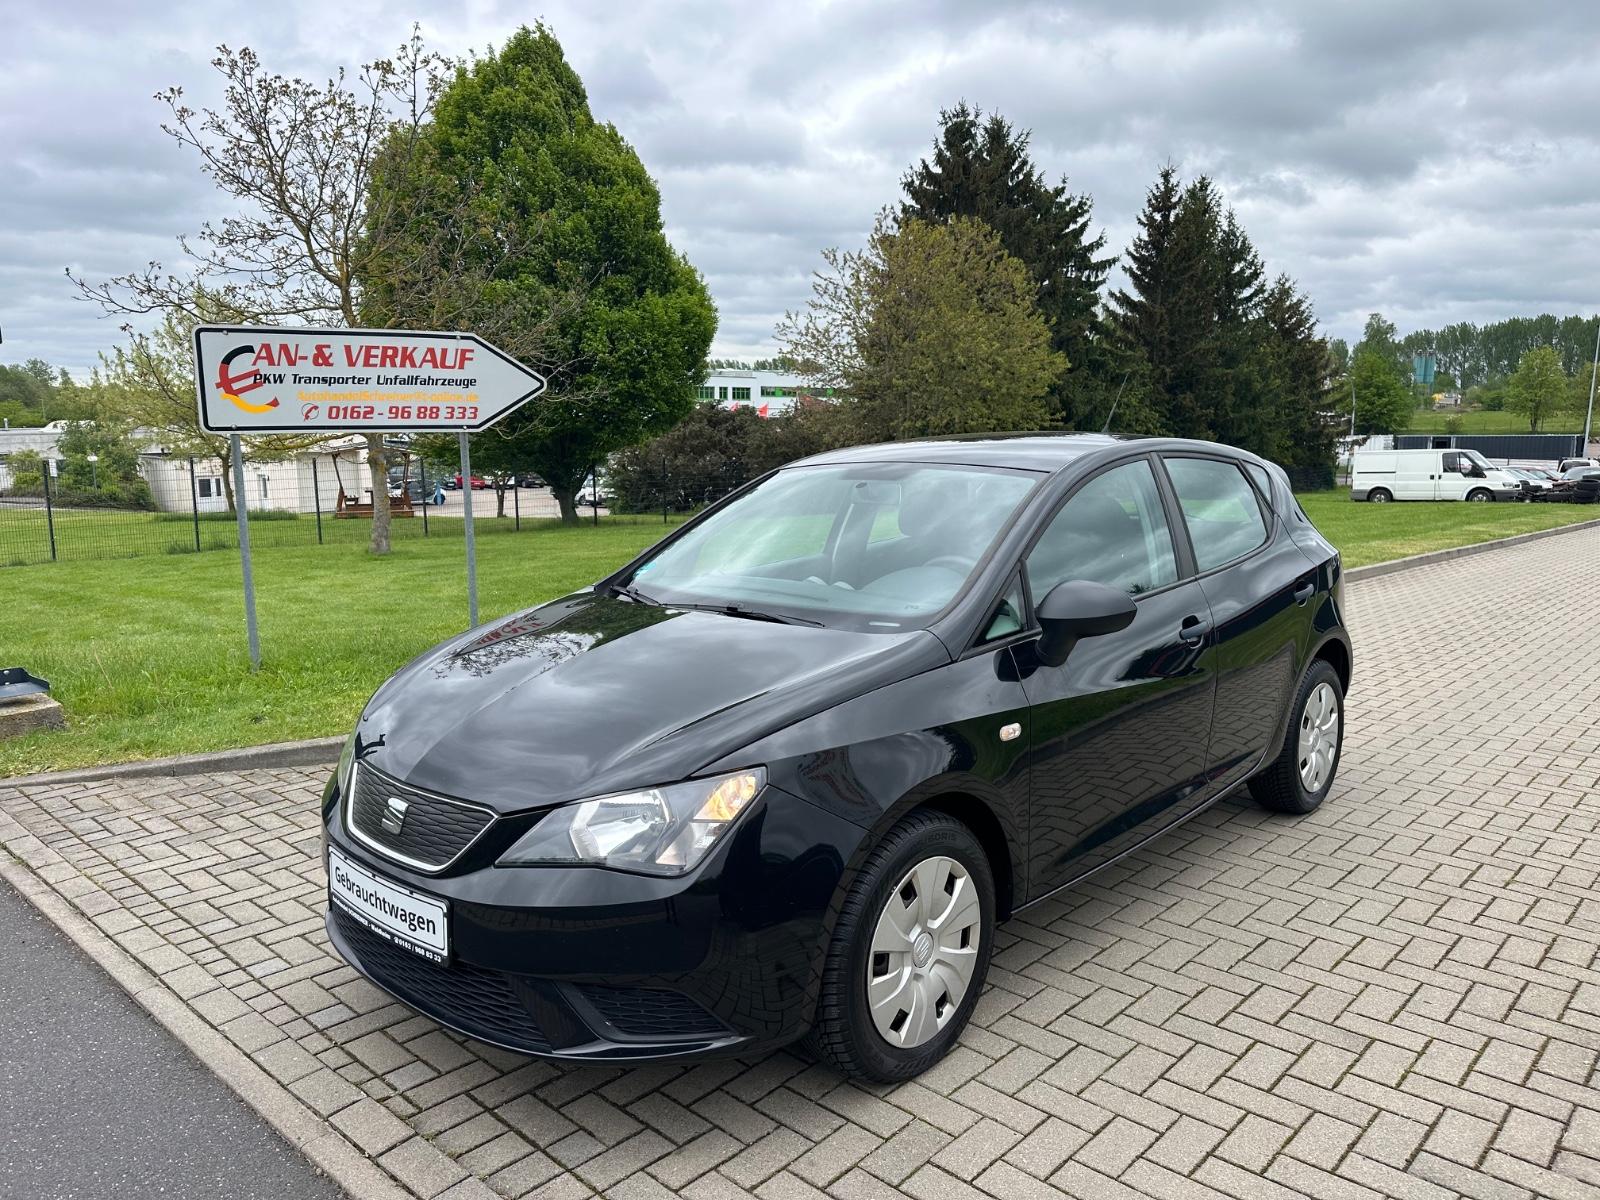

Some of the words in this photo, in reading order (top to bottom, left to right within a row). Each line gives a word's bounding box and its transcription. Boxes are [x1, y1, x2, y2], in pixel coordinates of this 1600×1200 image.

[343, 345, 475, 370] VERKAUF
[253, 373, 286, 385] PKW
[292, 373, 371, 387] Transporter
[376, 375, 477, 389] Unfallfahrzeuge
[327, 405, 375, 420] 0162
[388, 405, 412, 420] 96
[416, 405, 440, 420] 88
[444, 405, 479, 420] 333
[335, 866, 436, 935] Gebrauchtwagen
